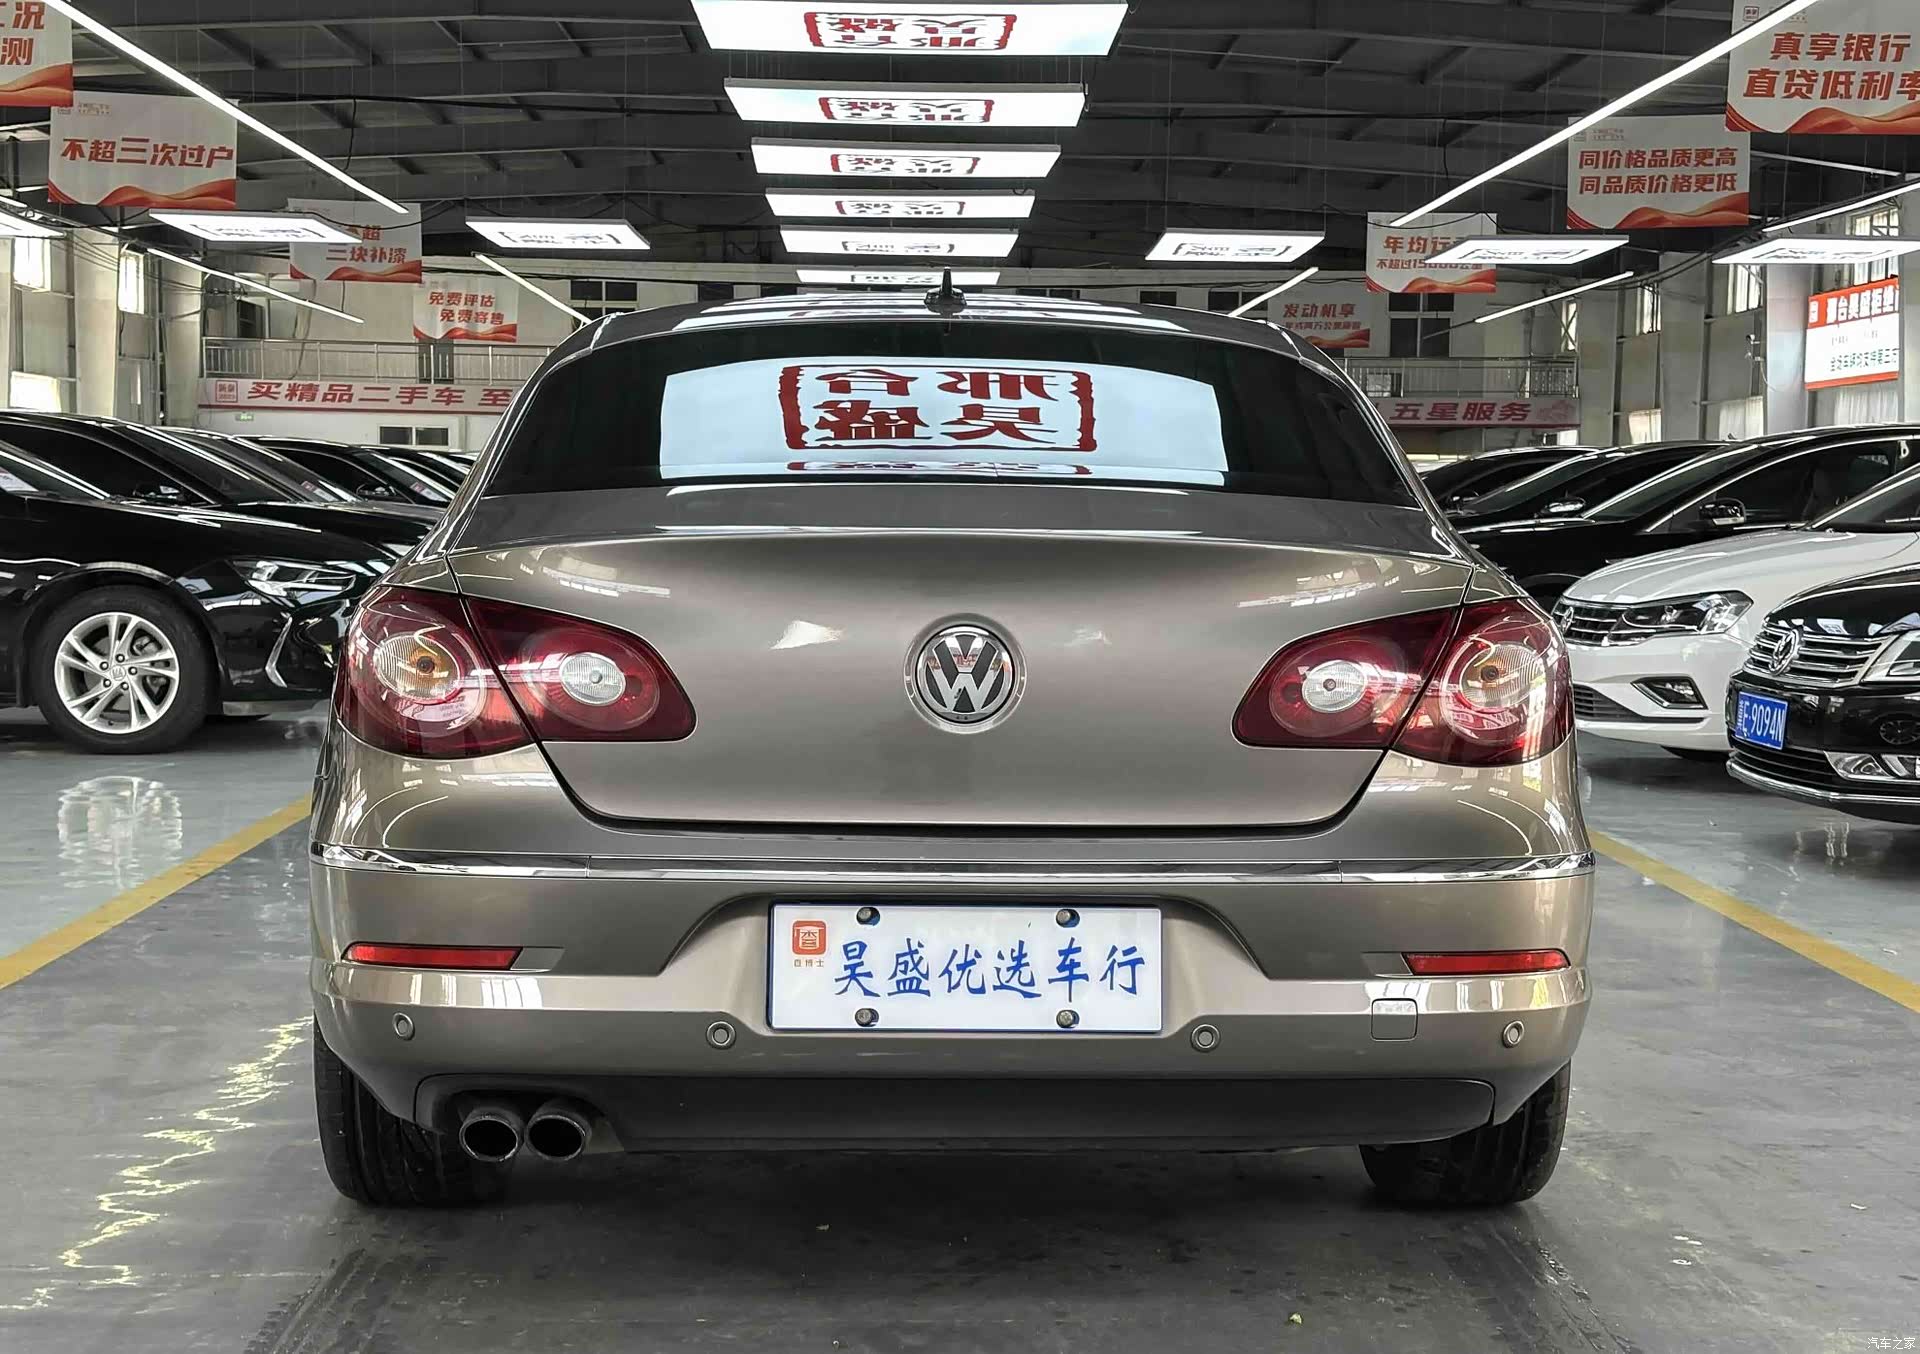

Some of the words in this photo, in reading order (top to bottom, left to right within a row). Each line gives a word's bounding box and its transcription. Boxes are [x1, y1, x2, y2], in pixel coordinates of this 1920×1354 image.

[0, 2, 45, 29] 况
[0, 37, 34, 65] 测
[1770, 32, 1911, 62] 真享银行
[1743, 68, 1920, 101] 直贷低利率
[61, 137, 234, 168] 不超三次过户
[1579, 147, 1738, 169] 同价格品质更高
[1579, 173, 1738, 195] 同品质价格更低
[326, 243, 407, 263] 三块补漆
[1383, 236, 1467, 254] 年均行
[429, 291, 495, 307] 免费评估
[439, 308, 505, 325] 免费寄售
[1283, 303, 1356, 318] 发动机享
[248, 381, 465, 406] 买精品二手车
[1389, 402, 1532, 421] 五星服务
[834, 937, 1145, 1003] 昊盛优选车行
